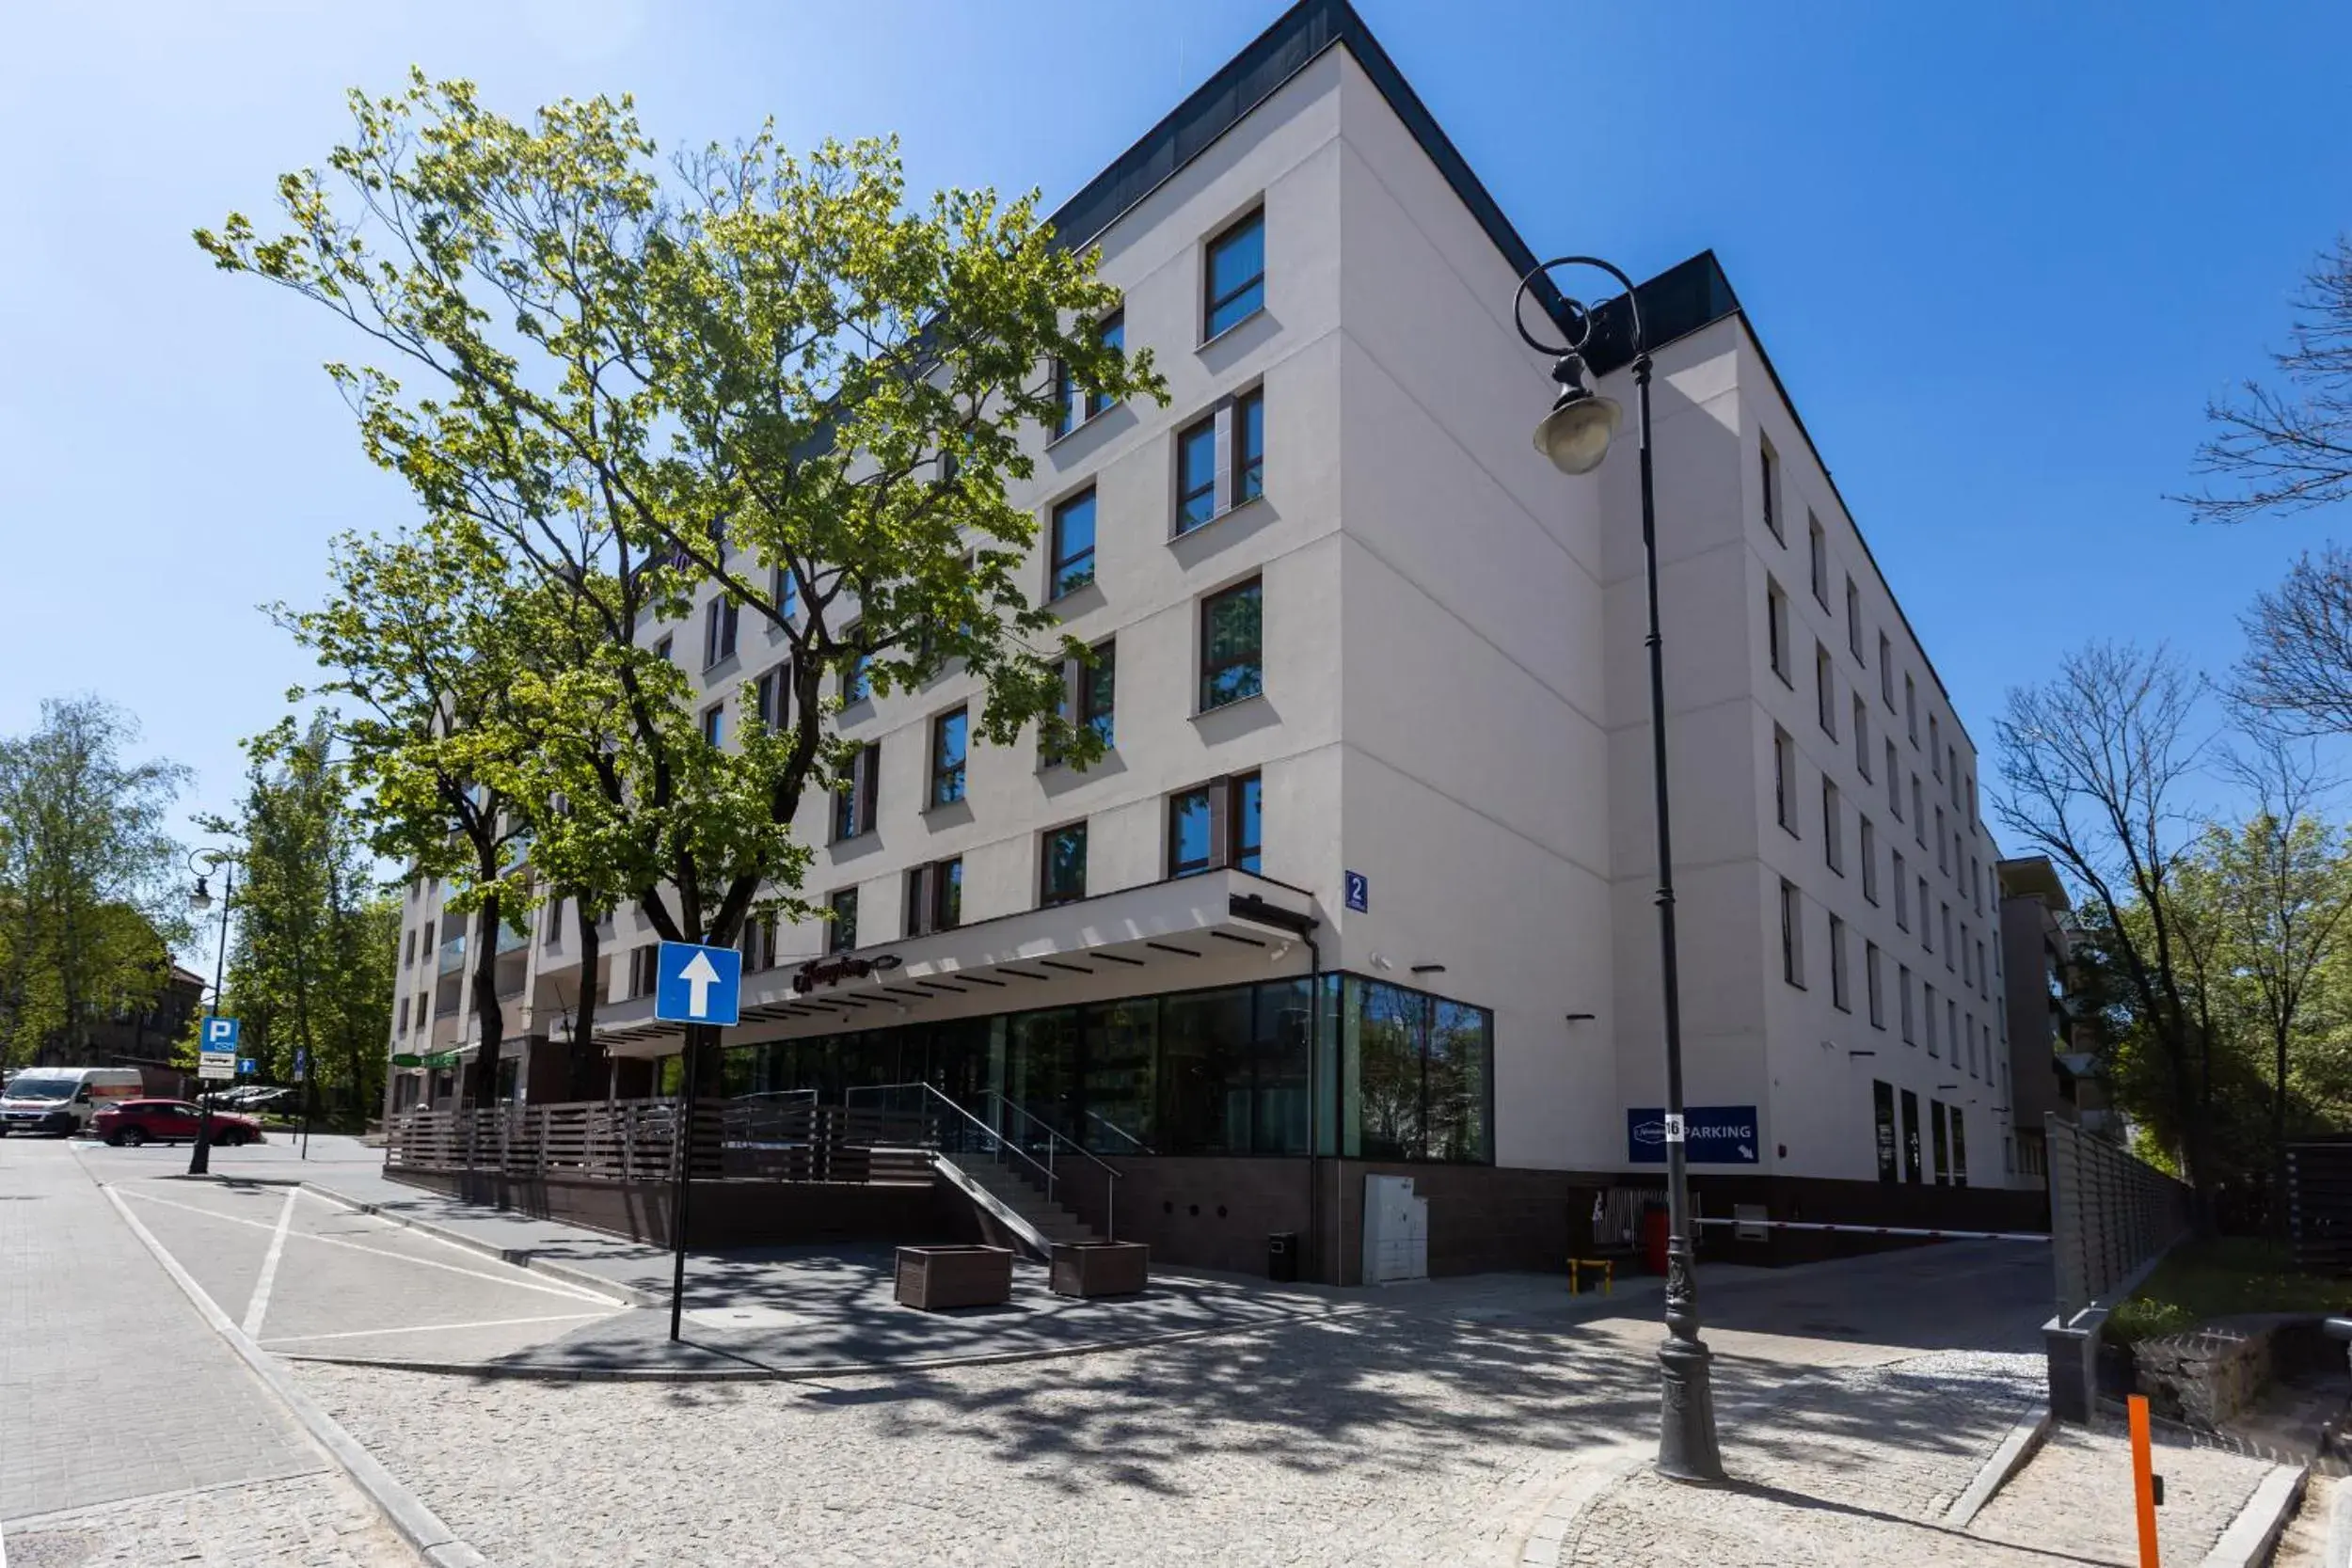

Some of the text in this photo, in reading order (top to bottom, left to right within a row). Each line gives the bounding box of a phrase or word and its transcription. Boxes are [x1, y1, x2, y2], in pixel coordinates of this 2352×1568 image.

[1352, 878, 1362, 900] 2
[210, 1020, 231, 1042] P
[1666, 1120, 1680, 1135] 16
[1682, 1125, 1751, 1139] PARKING
